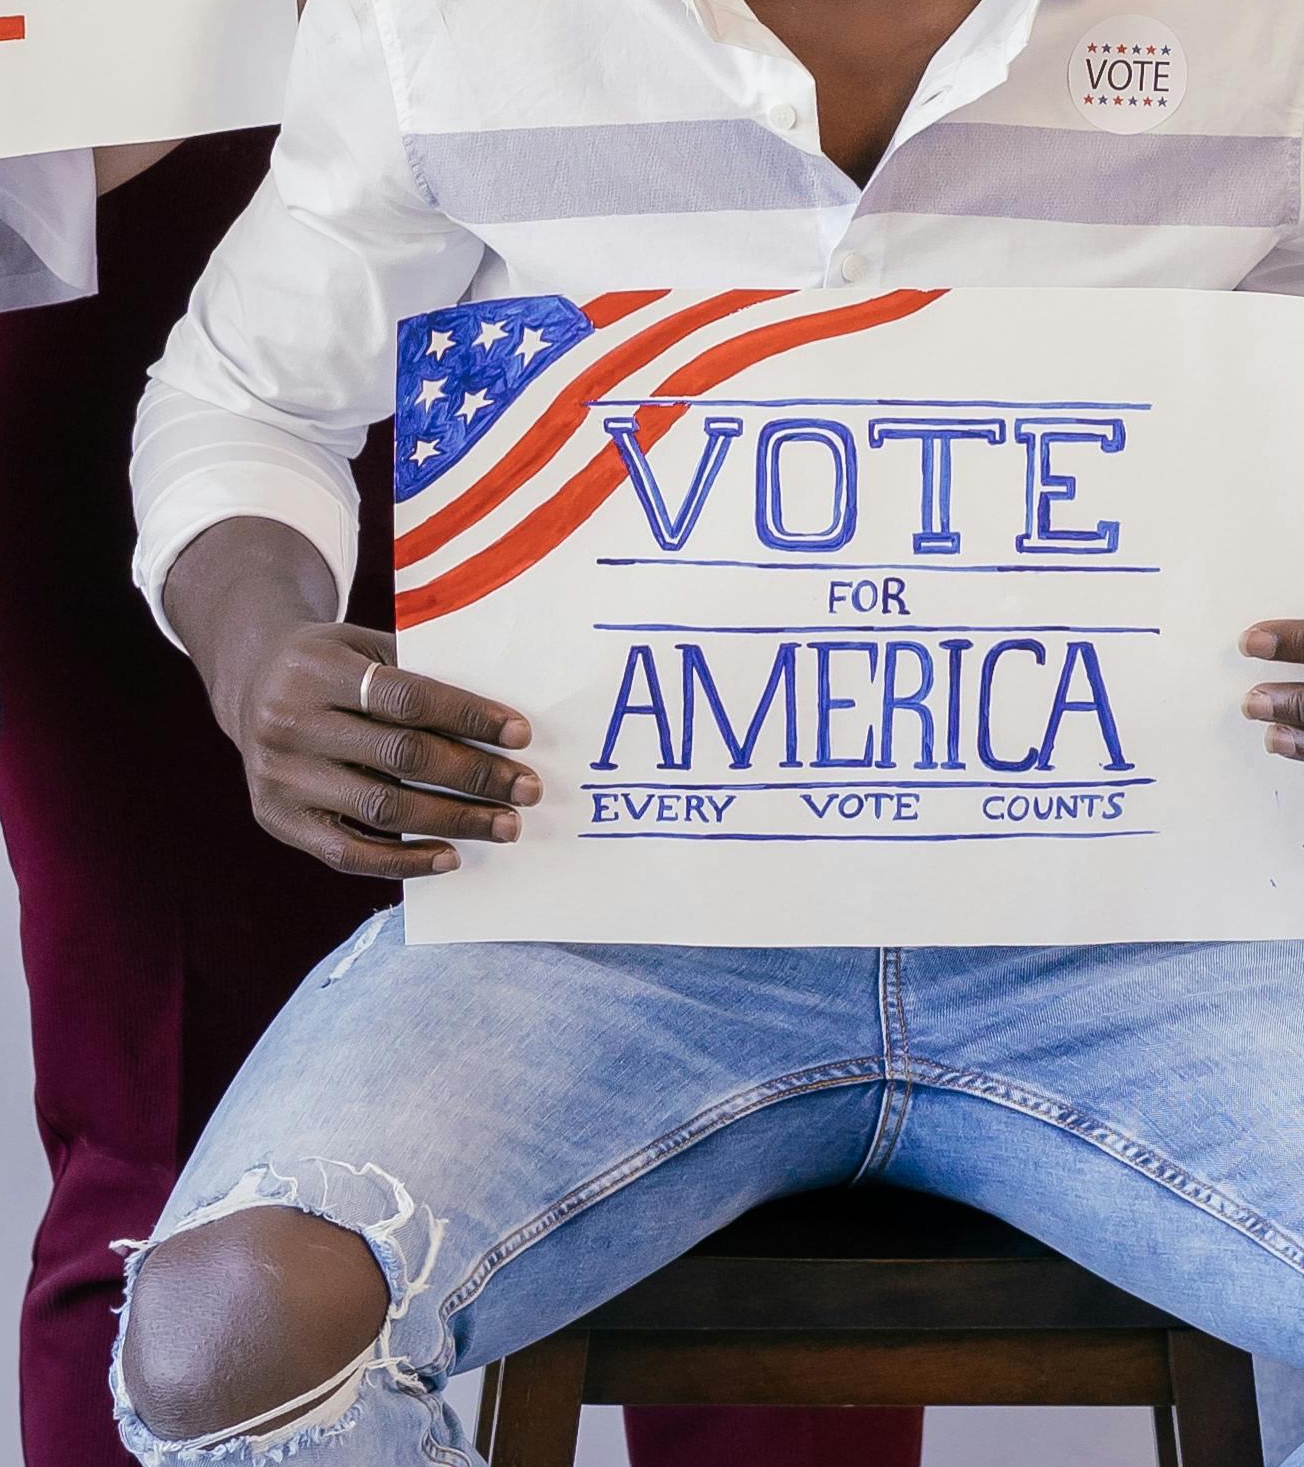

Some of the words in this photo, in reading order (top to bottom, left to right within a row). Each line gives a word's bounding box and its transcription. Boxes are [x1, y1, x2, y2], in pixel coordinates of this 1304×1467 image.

[1085, 58, 1171, 92] VOTE
[603, 417, 1127, 554] VOTE
[828, 577, 910, 614] FOR
[589, 638, 1135, 771] AMERICA
[591, 791, 736, 824] EVERY
[800, 792, 921, 821] VOTE
[982, 791, 1126, 821] COUNTS
